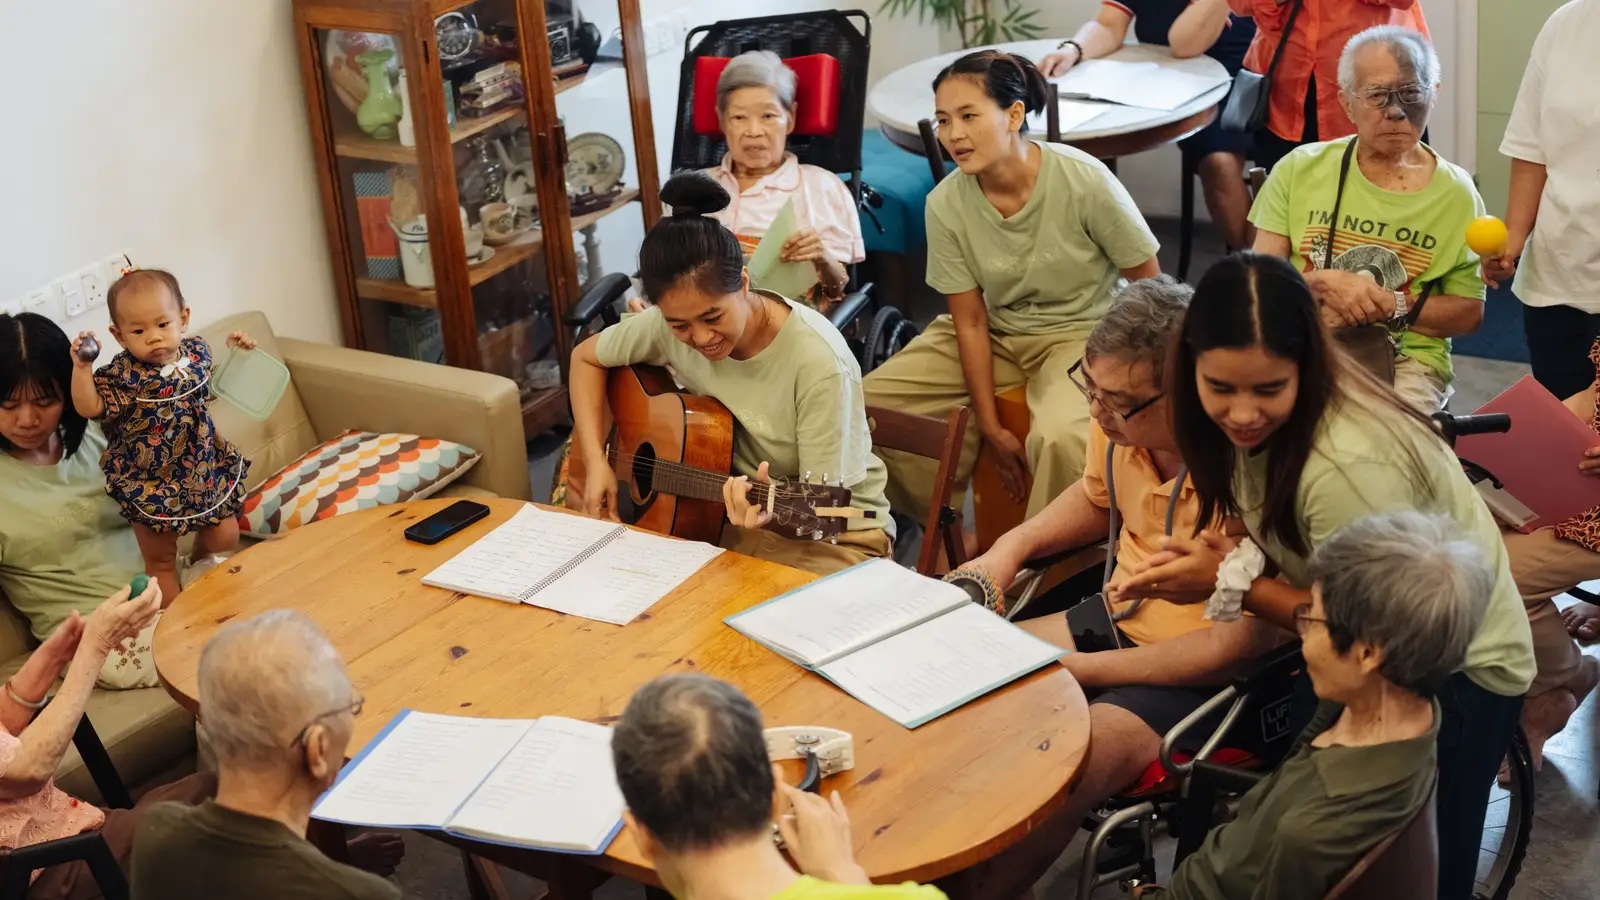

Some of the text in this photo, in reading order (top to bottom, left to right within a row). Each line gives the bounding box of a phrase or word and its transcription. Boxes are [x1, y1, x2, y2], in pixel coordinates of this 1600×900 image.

[1308, 210, 1437, 250] I'M NOT OLD
[1267, 702, 1291, 723] LIF
